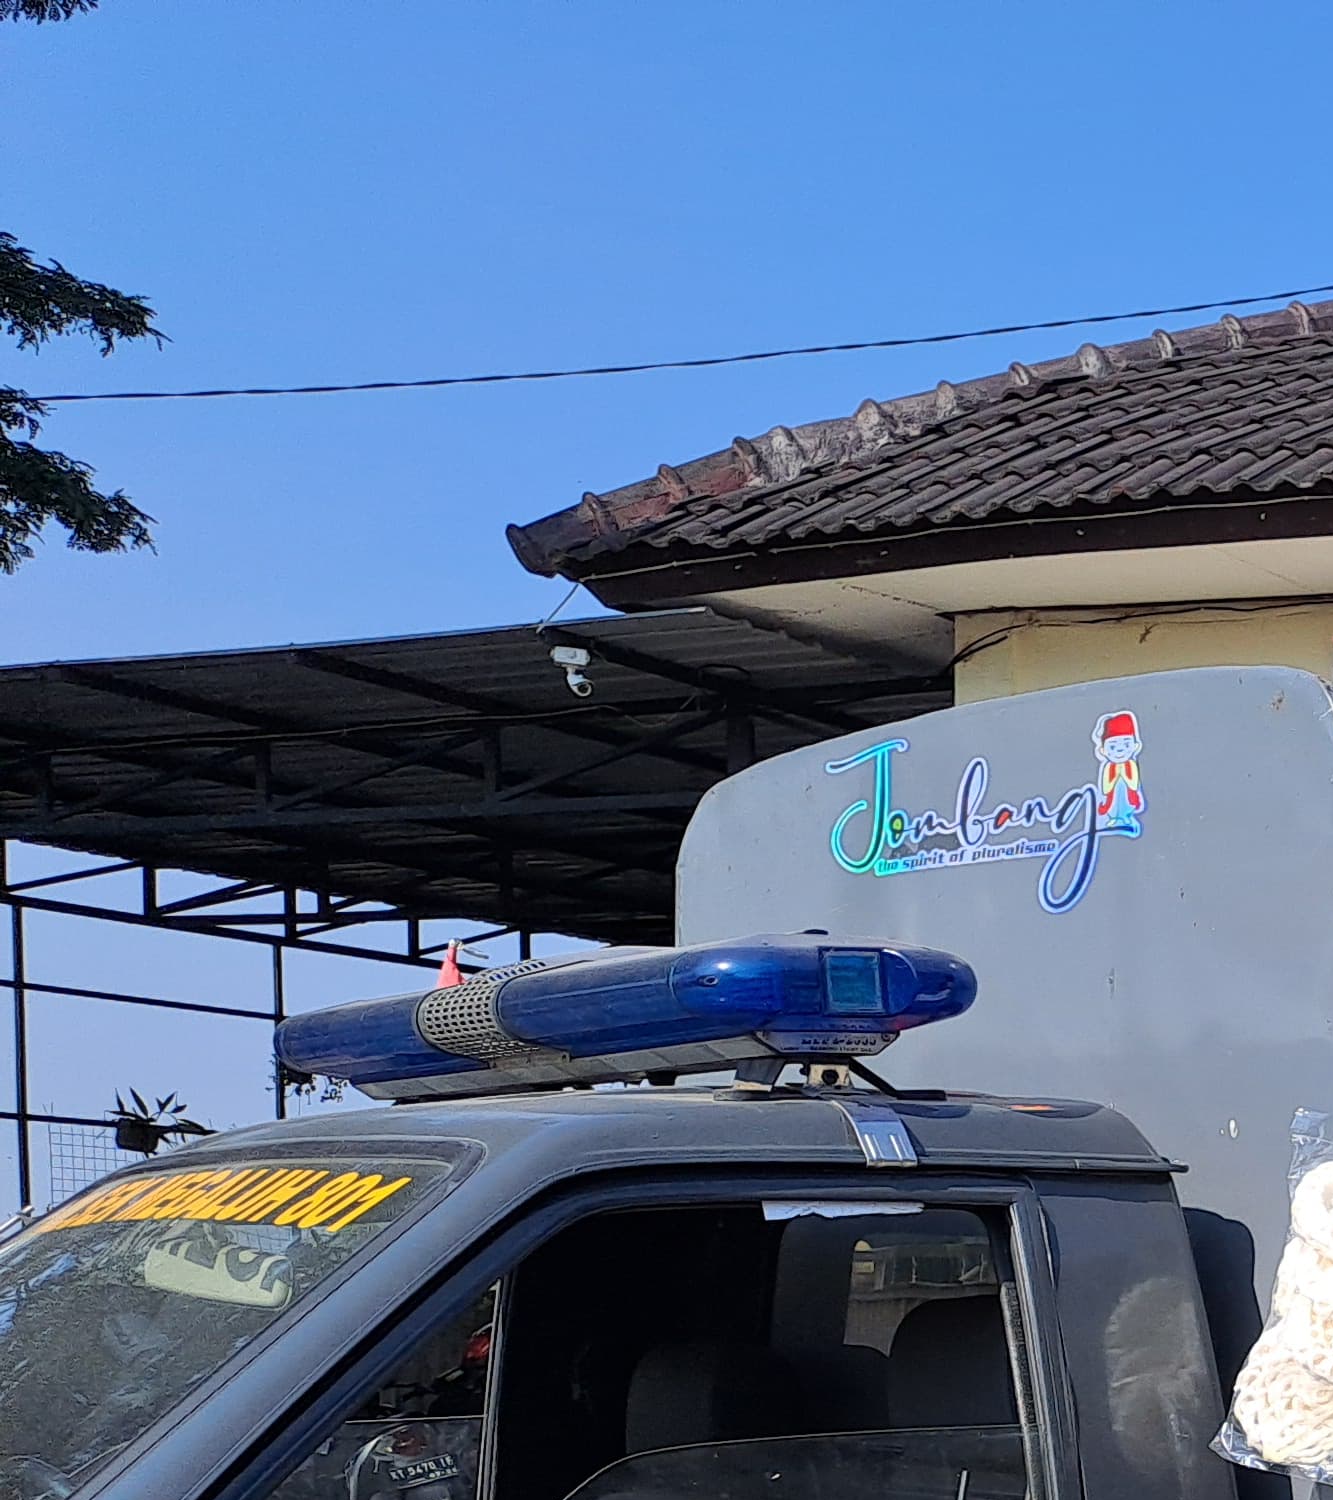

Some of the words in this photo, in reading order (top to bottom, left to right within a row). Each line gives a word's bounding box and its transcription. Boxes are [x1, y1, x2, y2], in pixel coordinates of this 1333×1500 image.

[825, 738, 1142, 913] Jombang
[903, 851, 944, 869] spirit
[950, 849, 965, 861] of
[274, 1171, 412, 1233] 801
